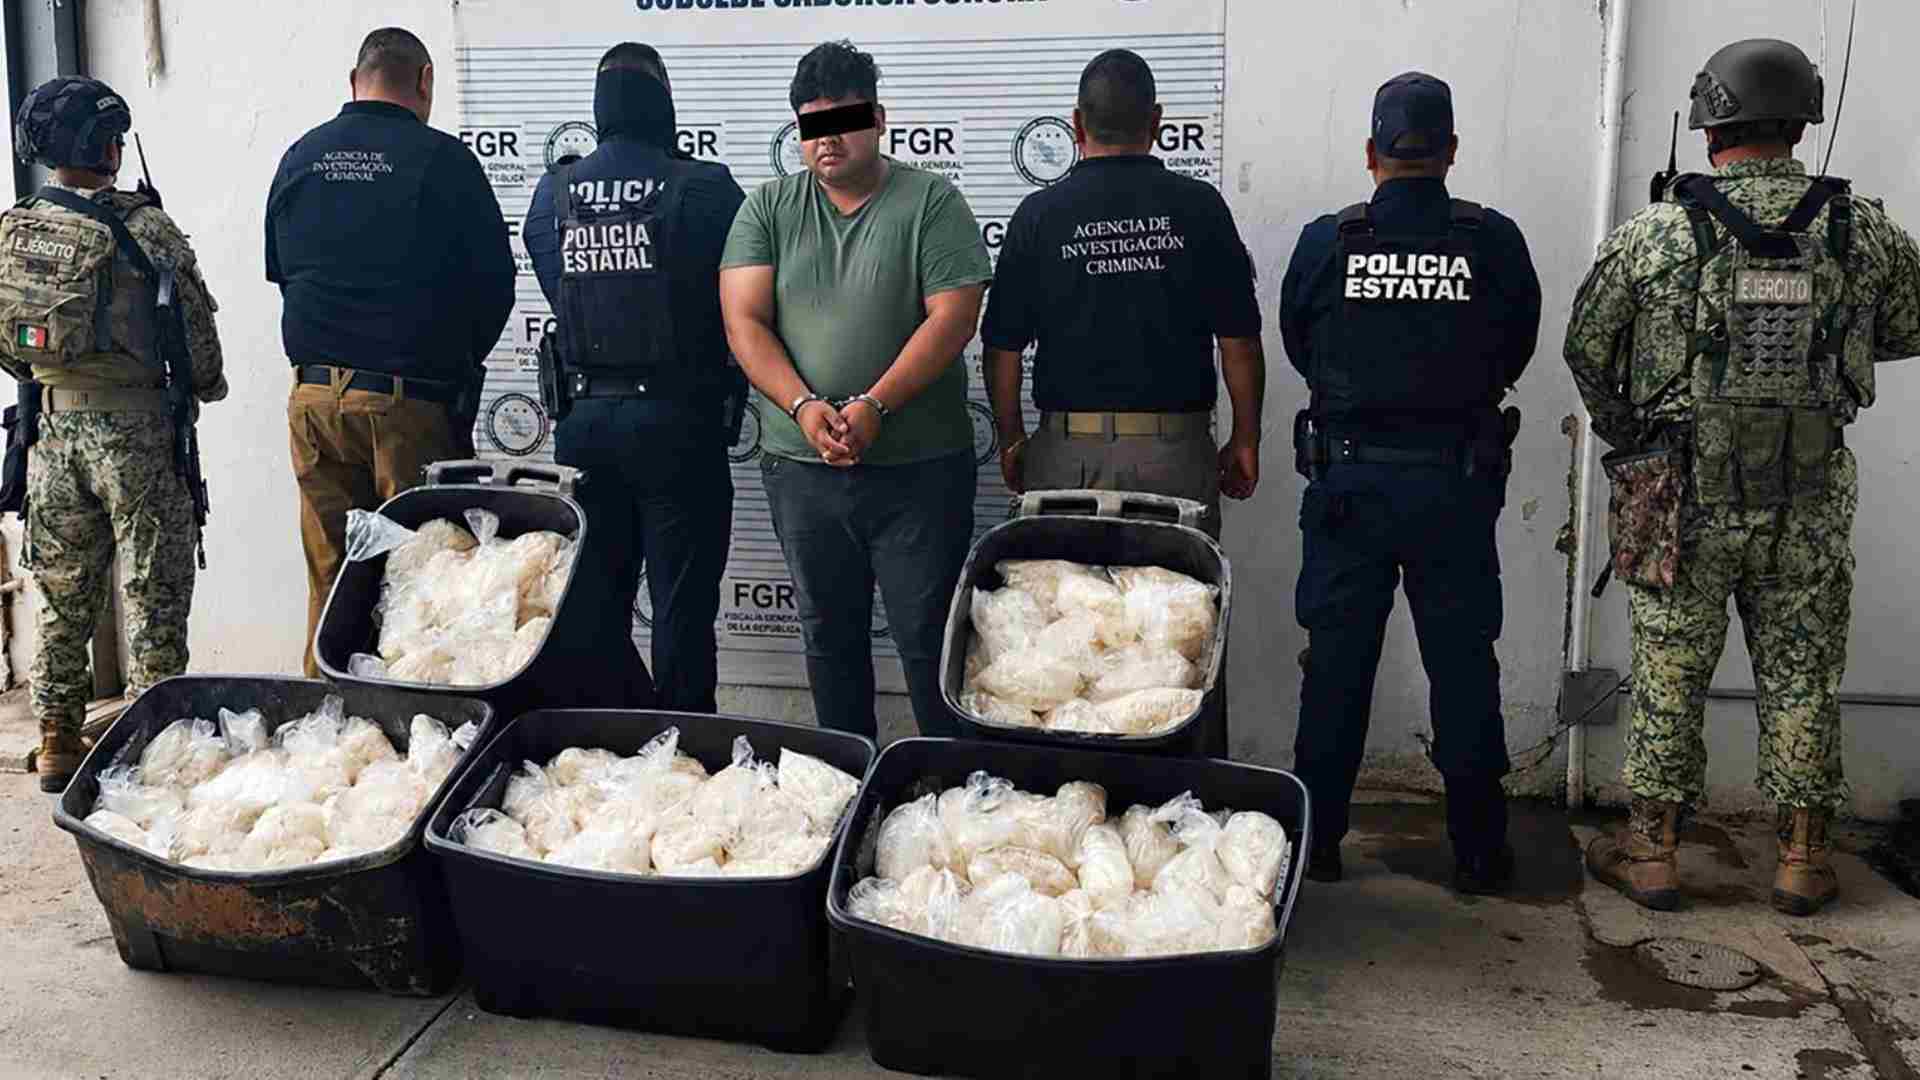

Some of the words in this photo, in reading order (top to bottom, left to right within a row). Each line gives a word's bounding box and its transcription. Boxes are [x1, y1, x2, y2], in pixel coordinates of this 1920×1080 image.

[674, 130, 719, 157] GR
[890, 127, 956, 155] FGR
[1158, 123, 1205, 151] GR
[1073, 218, 1146, 239] AGENCIA
[1148, 216, 1172, 232] DE
[1060, 231, 1185, 260] INVESTIGACIÓN
[562, 246, 653, 273] ESTATAL
[1086, 255, 1167, 275] CRIMINAL
[1346, 253, 1472, 279] POLICIA
[1344, 277, 1471, 301] ESTATAL
[734, 583, 796, 609] FGR
